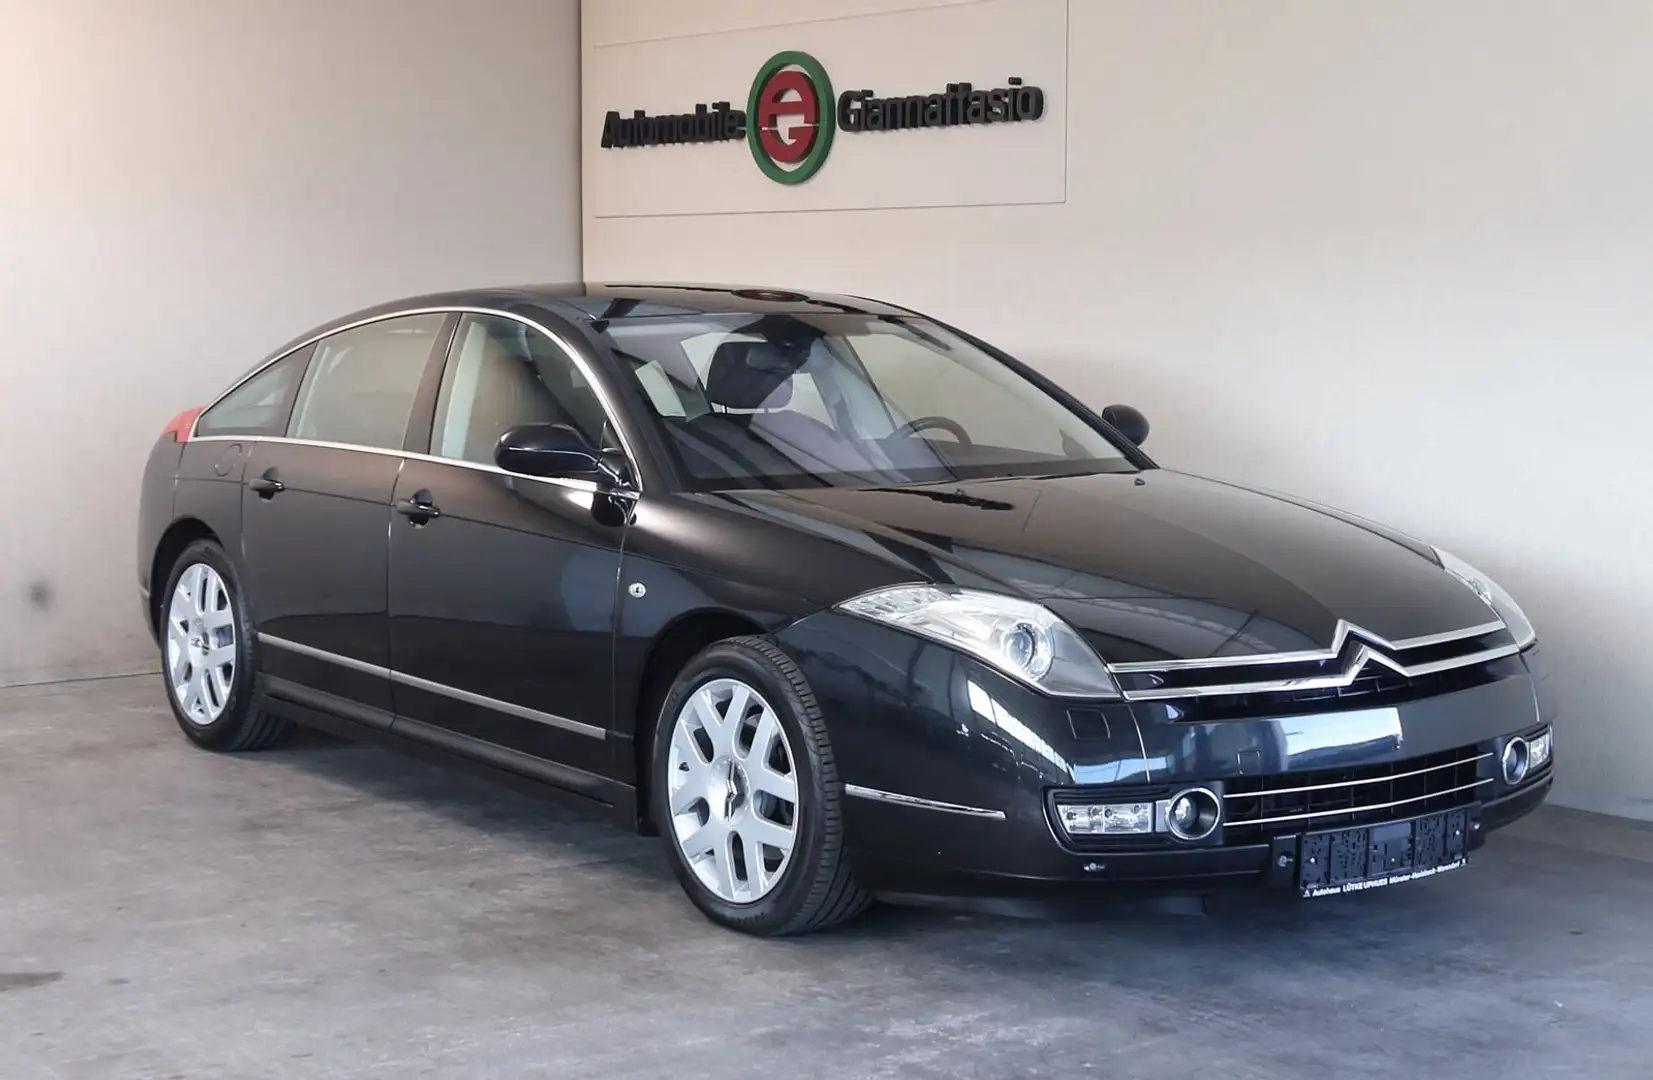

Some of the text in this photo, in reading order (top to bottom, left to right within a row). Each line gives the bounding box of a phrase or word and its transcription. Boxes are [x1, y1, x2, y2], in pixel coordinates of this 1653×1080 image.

[601, 101, 747, 148] Automobile
[837, 77, 1044, 132] Giannaffasio
[1312, 887, 1341, 897] Autohaus
